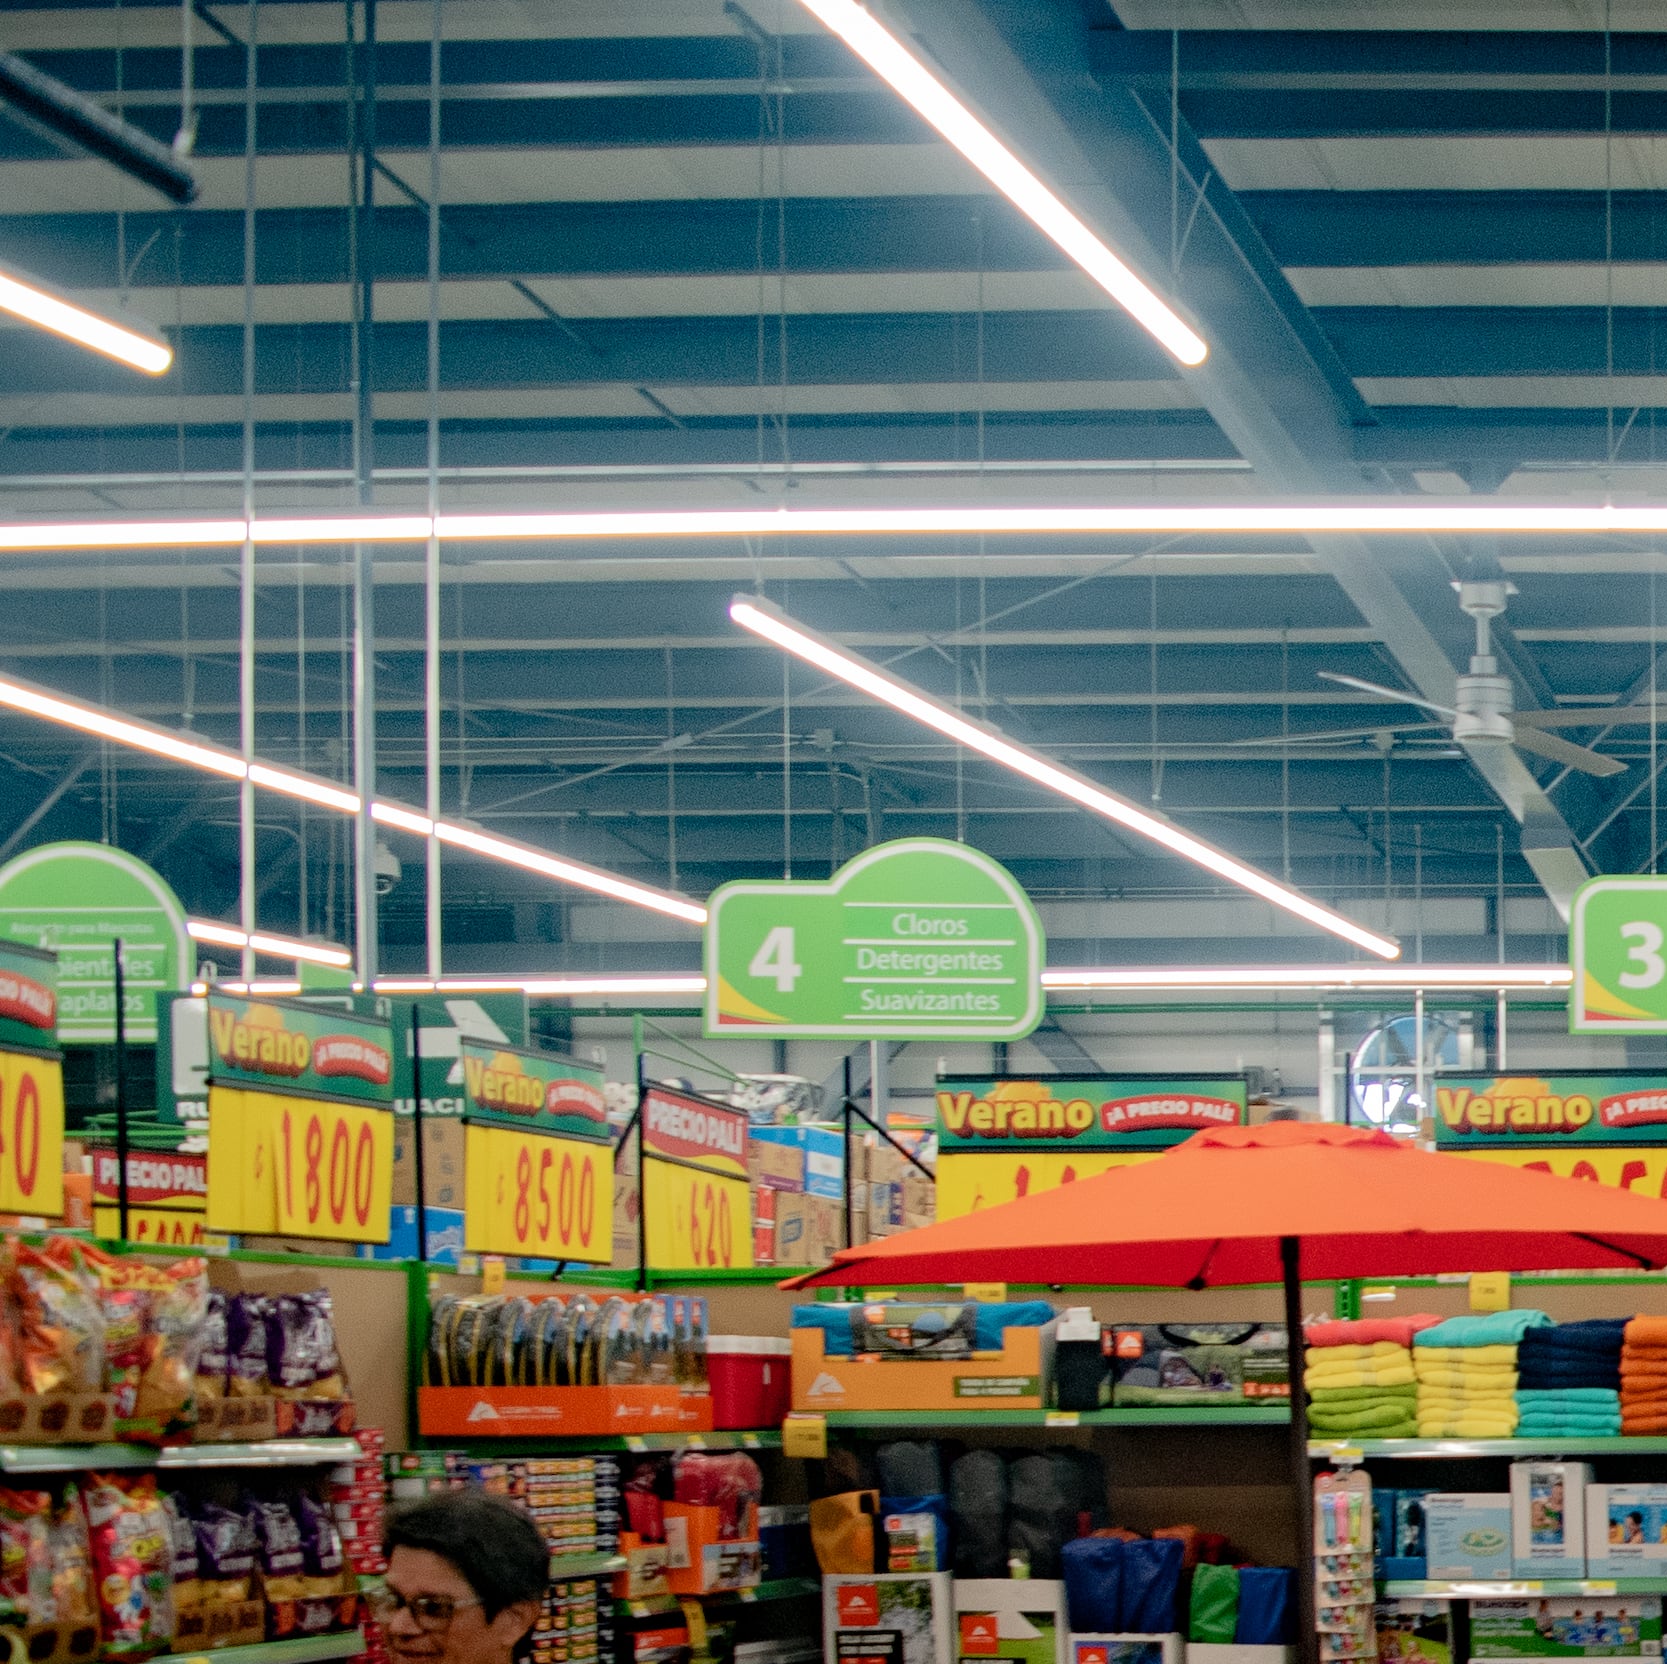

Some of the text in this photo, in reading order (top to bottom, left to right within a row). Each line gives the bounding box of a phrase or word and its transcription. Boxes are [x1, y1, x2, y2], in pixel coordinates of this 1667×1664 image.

[892, 913, 968, 937] Cloros
[748, 927, 801, 992] 4
[857, 947, 1003, 977] Detergentes
[1618, 922, 1665, 989] 3
[860, 988, 1000, 1012] Suavizantes
[211, 1008, 311, 1074] Verano
[464, 1054, 545, 1115] Verano
[936, 1092, 1094, 1134] Verano
[1127, 1100, 1189, 1119] PRECIO
[1435, 1087, 1593, 1130] Verano
[0, 1072, 39, 1197] 0
[649, 1097, 705, 1147] PRECIO
[708, 1117, 745, 1155] PALÍ
[100, 1158, 206, 1192] PECIO PAL
[282, 1108, 374, 1228] 1800
[514, 1146, 596, 1249] 8500
[690, 1180, 733, 1268] 620
